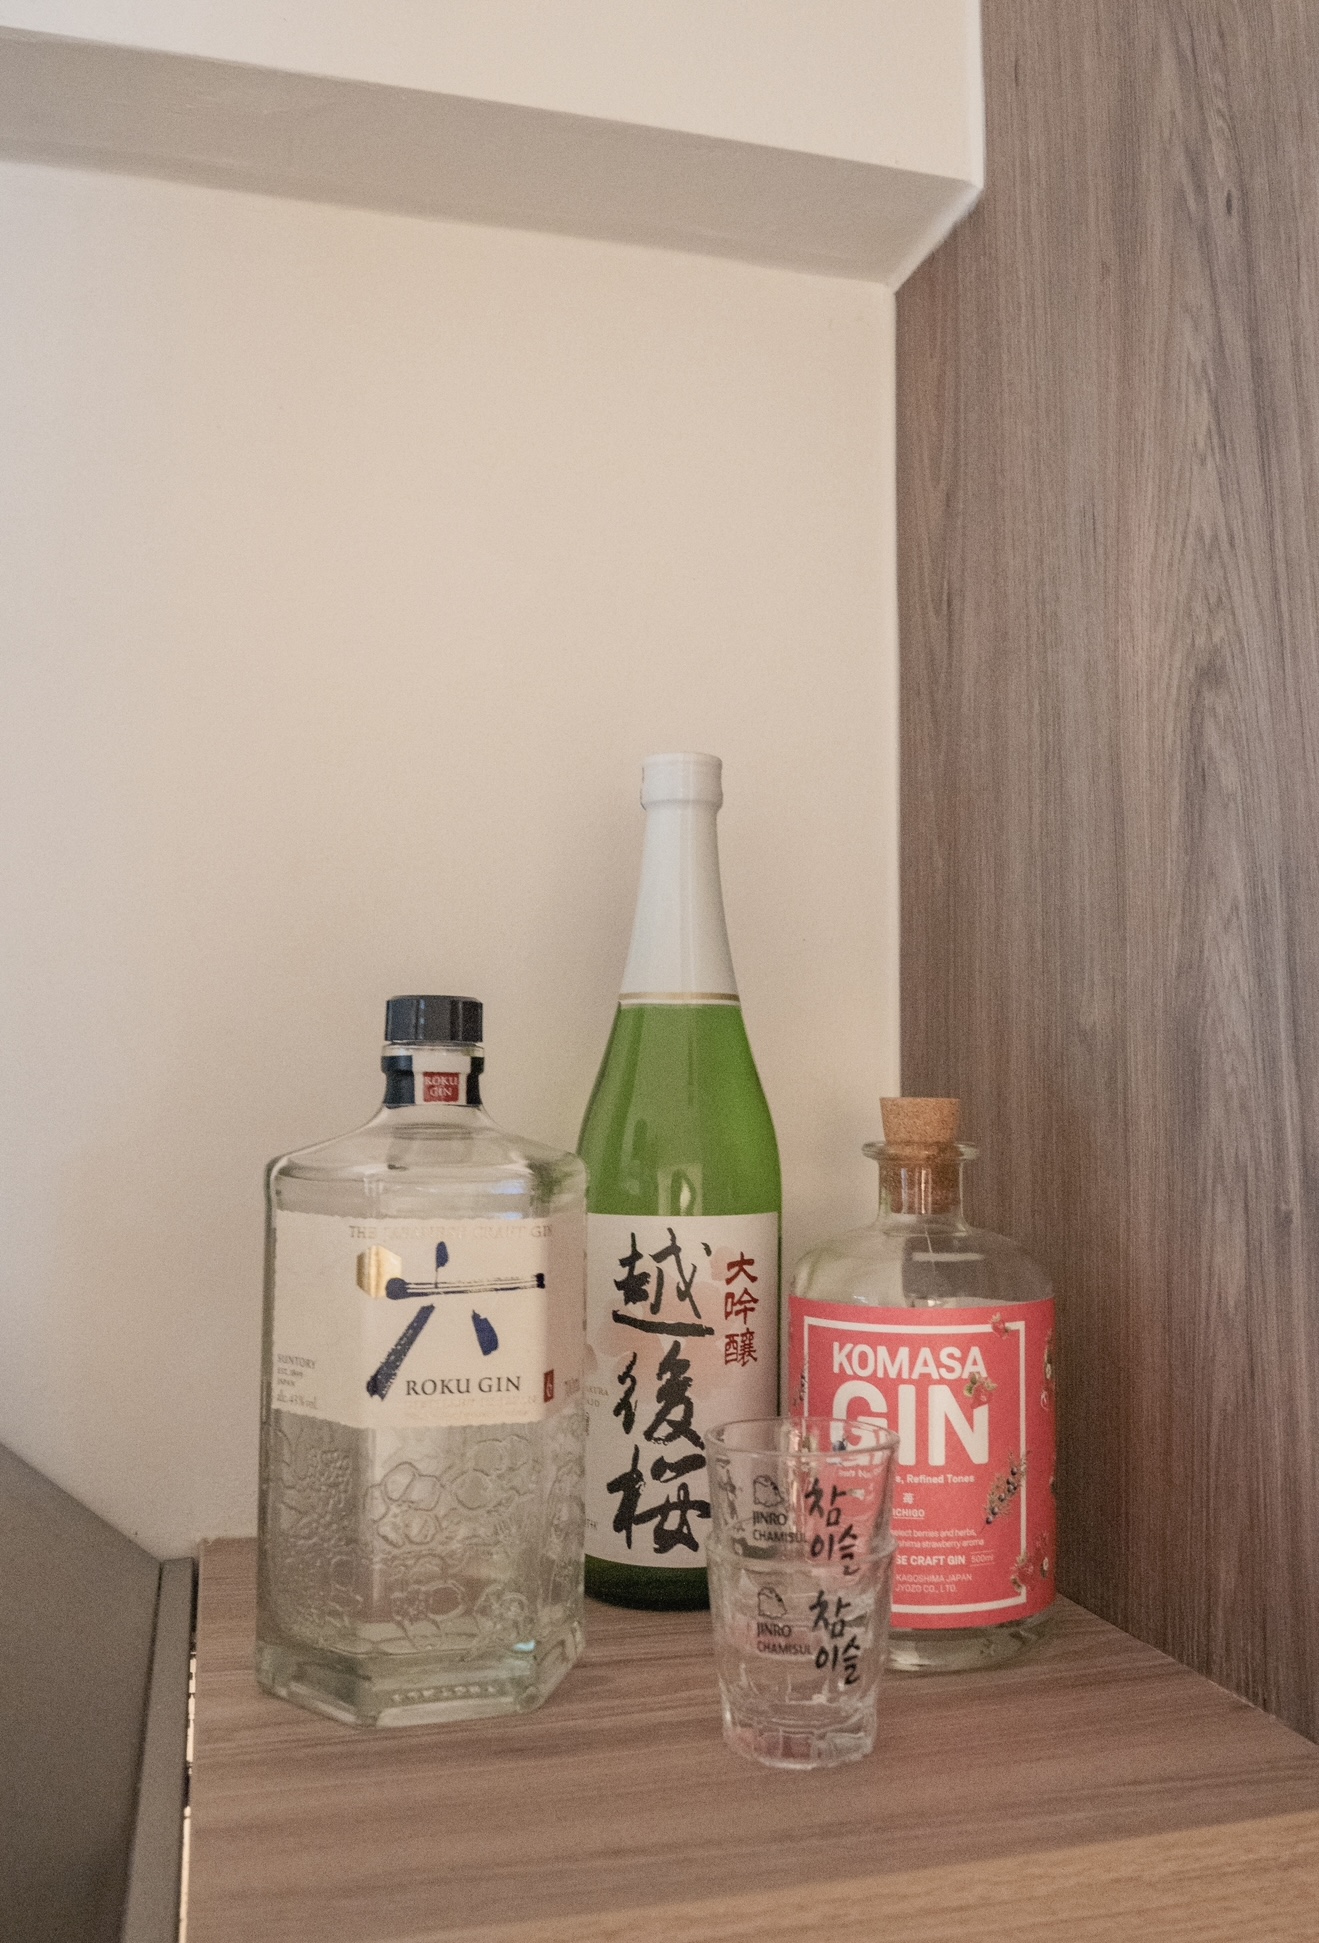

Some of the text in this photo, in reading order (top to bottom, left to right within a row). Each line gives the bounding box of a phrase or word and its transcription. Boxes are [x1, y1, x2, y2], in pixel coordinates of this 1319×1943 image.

[425, 1076, 457, 1086] ROKU
[430, 1086, 452, 1097] GIN
[831, 1341, 988, 1381] KOMASA
[406, 1375, 521, 1396] ROKU GIN
[831, 1380, 989, 1468] GIN
[907, 1474, 944, 1484] Refined
[947, 1474, 975, 1483] Tones
[804, 1477, 847, 1528] 참
[752, 1511, 788, 1526] JINRO
[892, 1508, 925, 1518] ICHIGO
[752, 1529, 807, 1543] CHAMISUL
[810, 1523, 859, 1576] 이슬
[909, 1554, 945, 1567] CRAFT
[947, 1555, 966, 1566] GIN
[808, 1589, 852, 1640] 참
[756, 1621, 792, 1638] JINRO
[756, 1640, 813, 1656] CHAMISUL
[815, 1633, 861, 1685] 이슬
